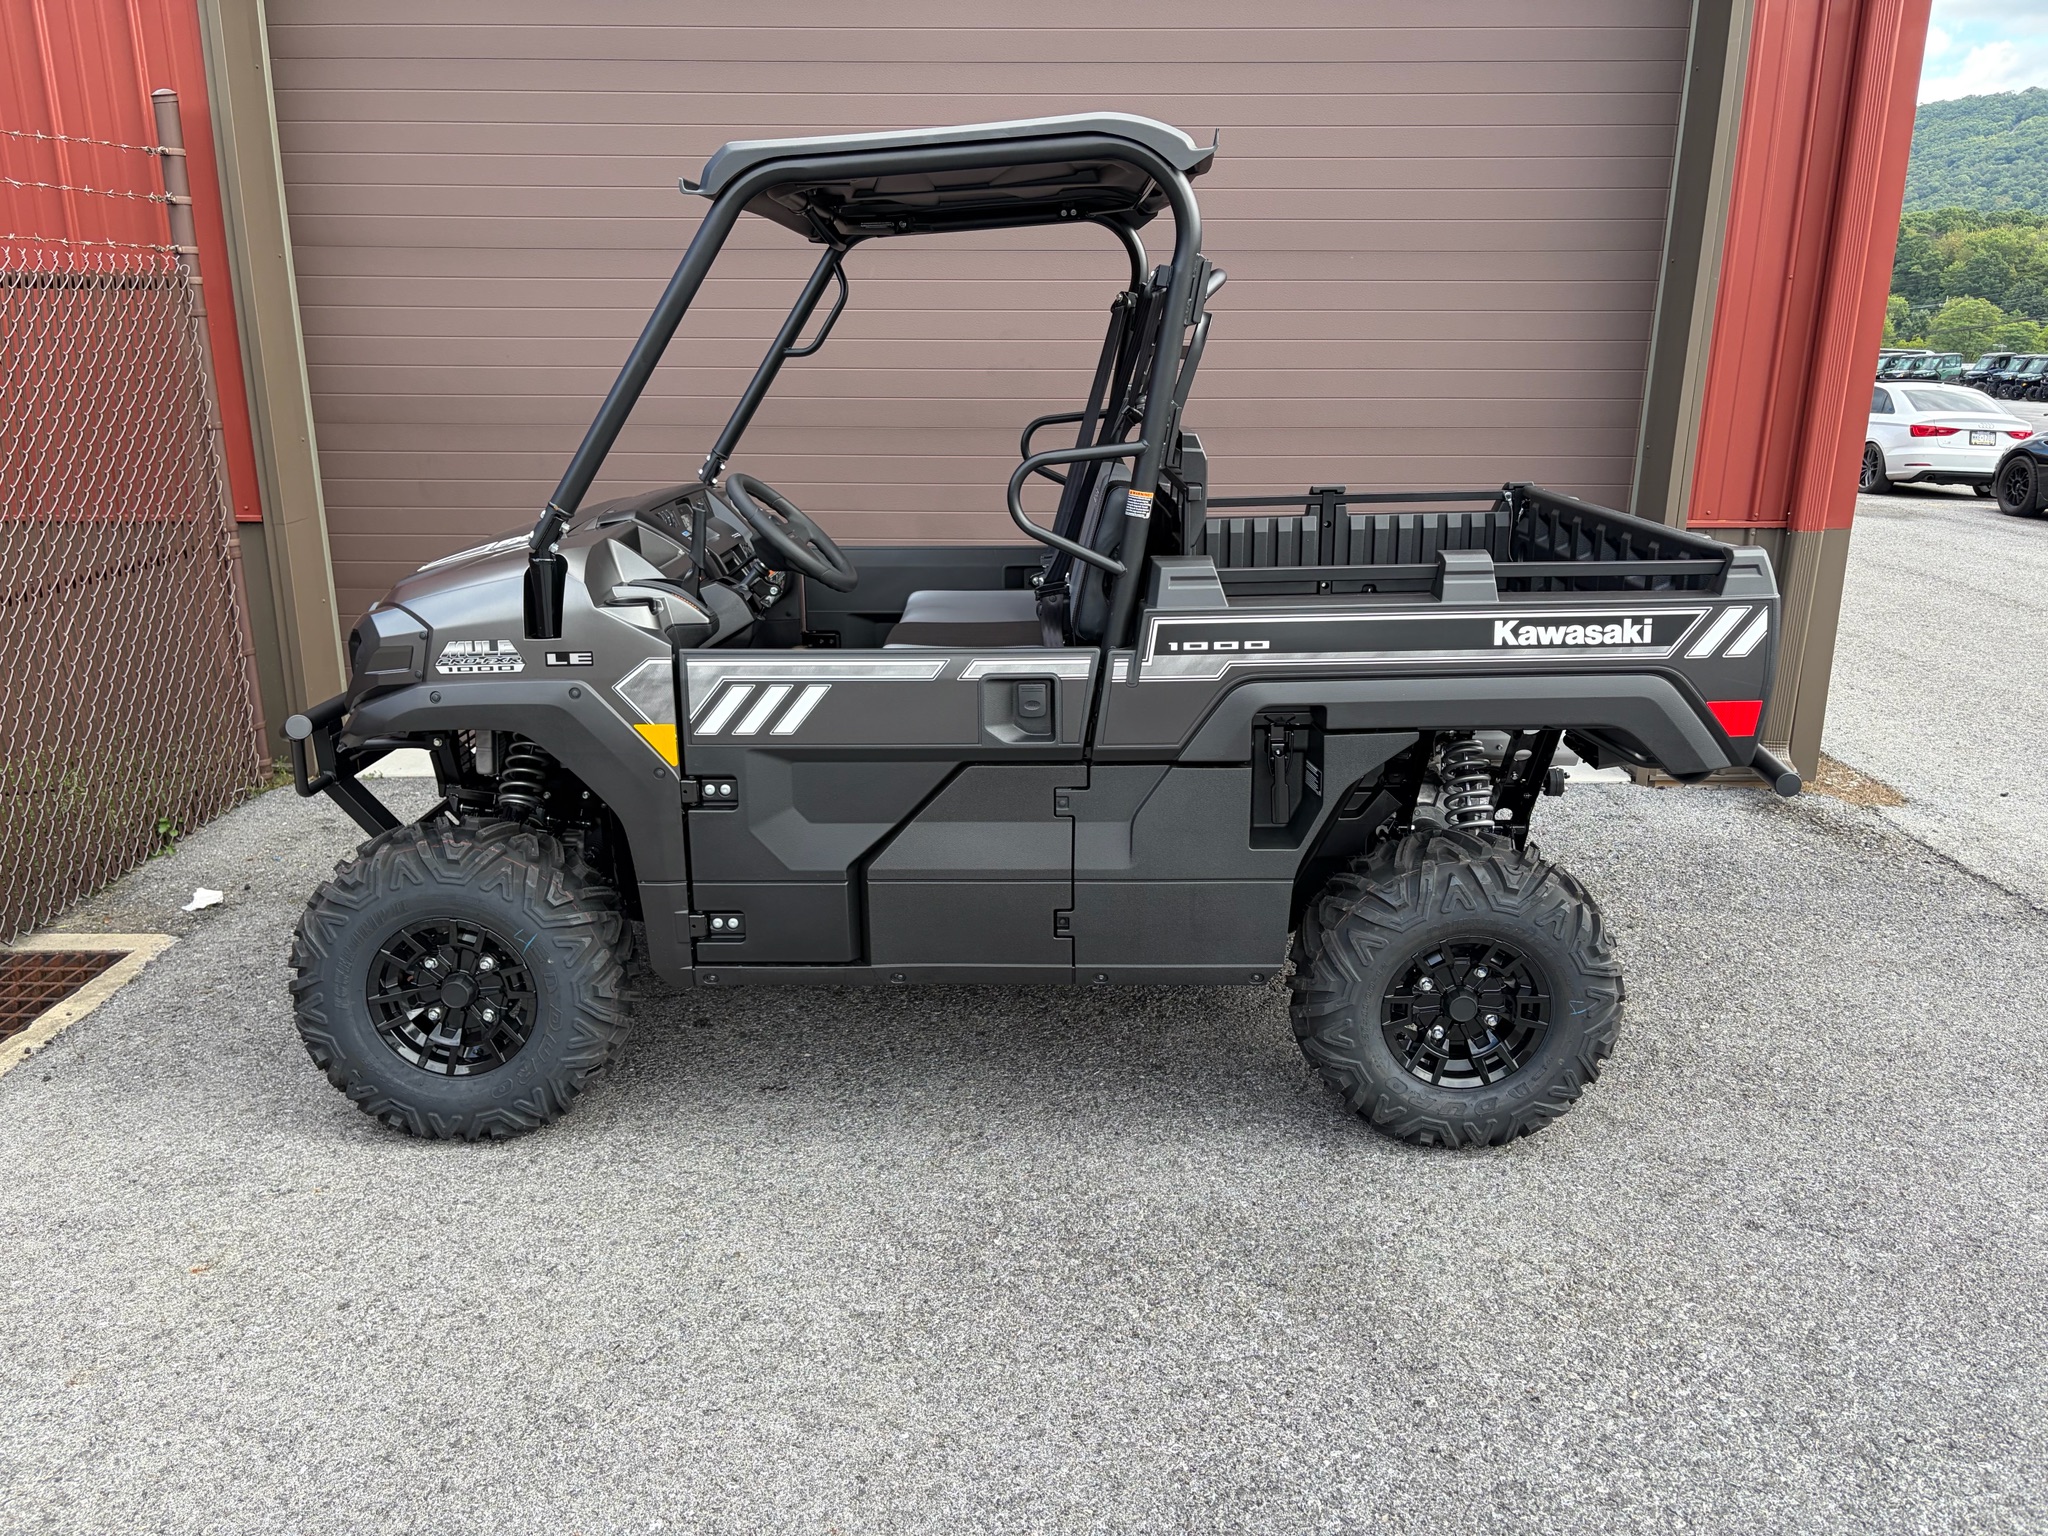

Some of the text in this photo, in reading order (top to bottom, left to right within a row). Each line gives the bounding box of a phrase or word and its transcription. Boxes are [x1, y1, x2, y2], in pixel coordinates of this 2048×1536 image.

[1494, 618, 1653, 646] Kawasaki
[440, 640, 520, 657] MULE
[1168, 641, 1270, 651] 1000
[547, 653, 593, 664] LE
[447, 665, 515, 673] 1000
